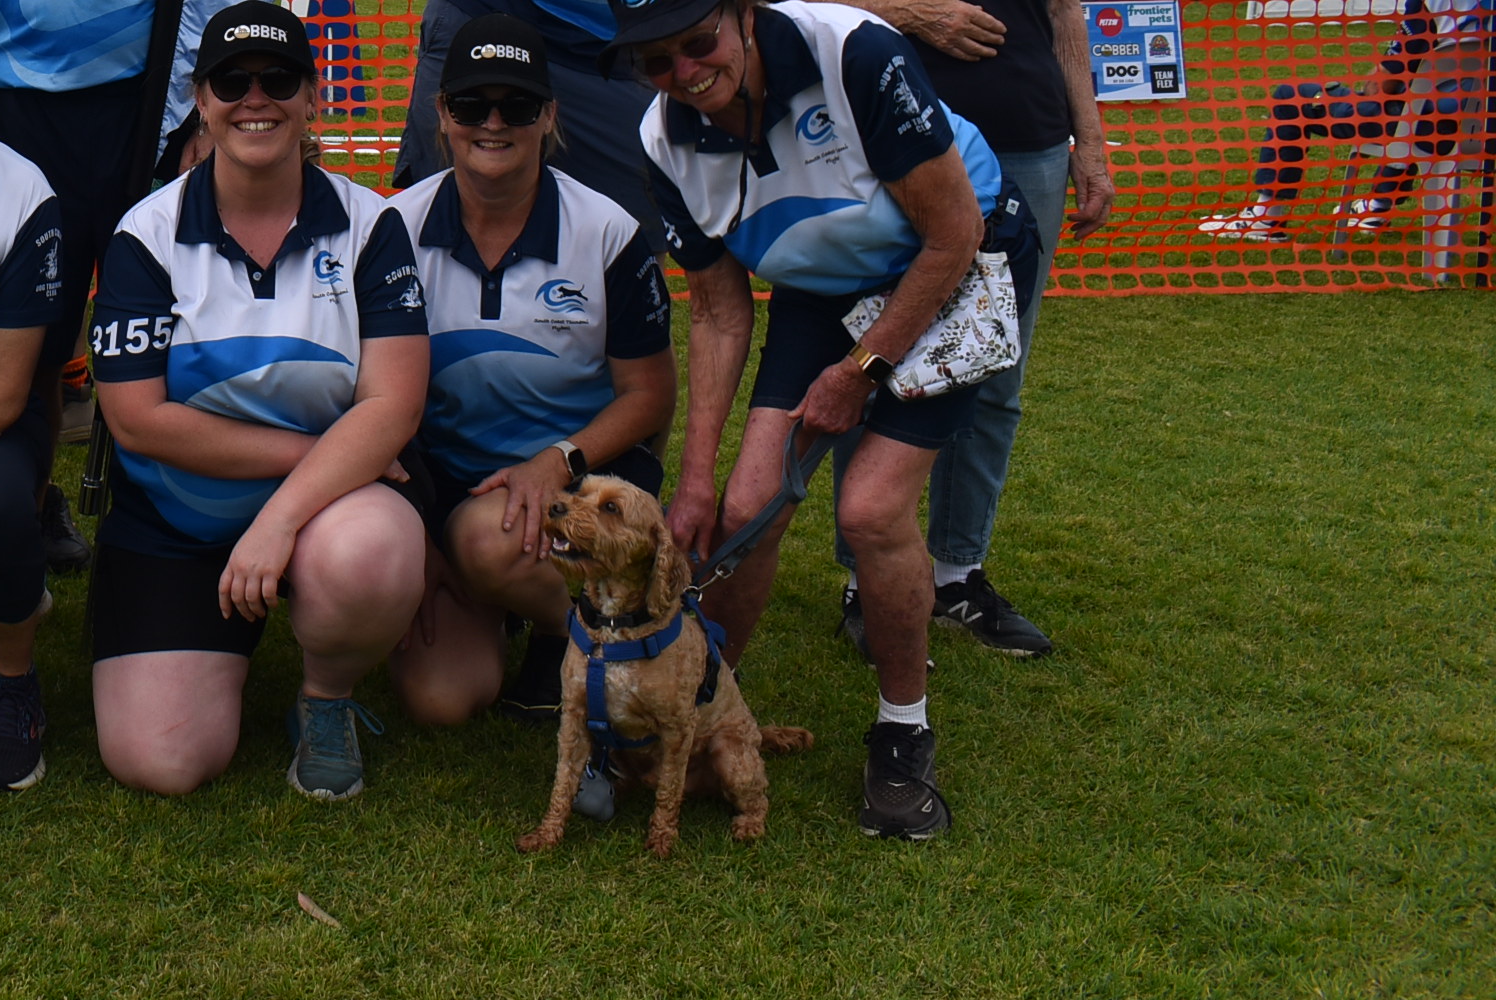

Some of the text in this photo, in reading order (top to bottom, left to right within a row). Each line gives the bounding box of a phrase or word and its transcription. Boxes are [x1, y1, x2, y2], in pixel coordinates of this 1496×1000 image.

[1127, 4, 1172, 17] frontier
[1149, 15, 1173, 26] pets
[224, 24, 288, 43] COBBER
[470, 43, 530, 64] COBBER
[1092, 43, 1141, 57] COBBER
[1105, 65, 1139, 78] DOG
[1154, 70, 1174, 80] TEAM
[1156, 80, 1174, 89] FLEX
[385, 265, 411, 285] SOUTH
[92, 316, 173, 356] 3155
